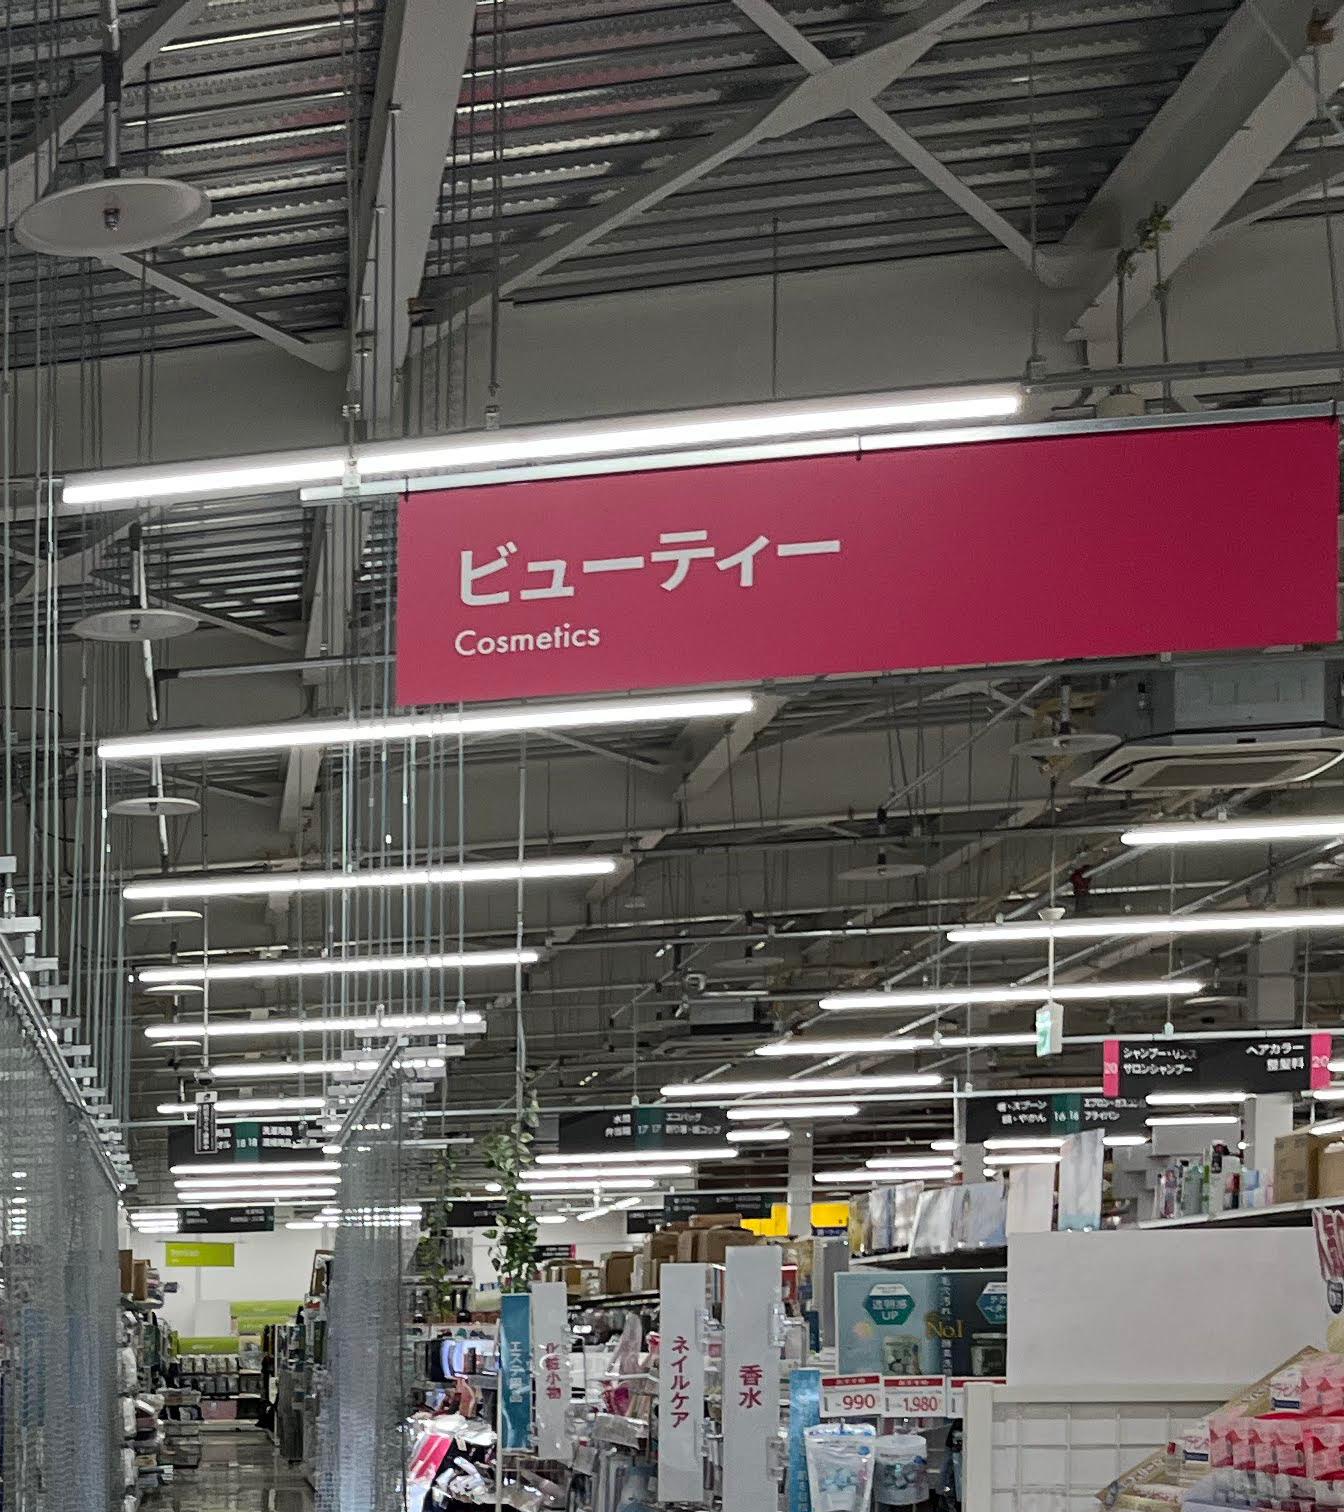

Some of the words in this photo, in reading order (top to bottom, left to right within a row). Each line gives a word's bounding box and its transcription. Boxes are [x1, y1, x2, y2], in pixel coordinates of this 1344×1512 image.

[457, 529, 841, 608] ビューティー
[453, 621, 601, 659] Cosmetics
[671, 1335, 690, 1429] ネイルケア
[738, 1364, 763, 1409] 香水
[843, 1394, 876, 1410] 990
